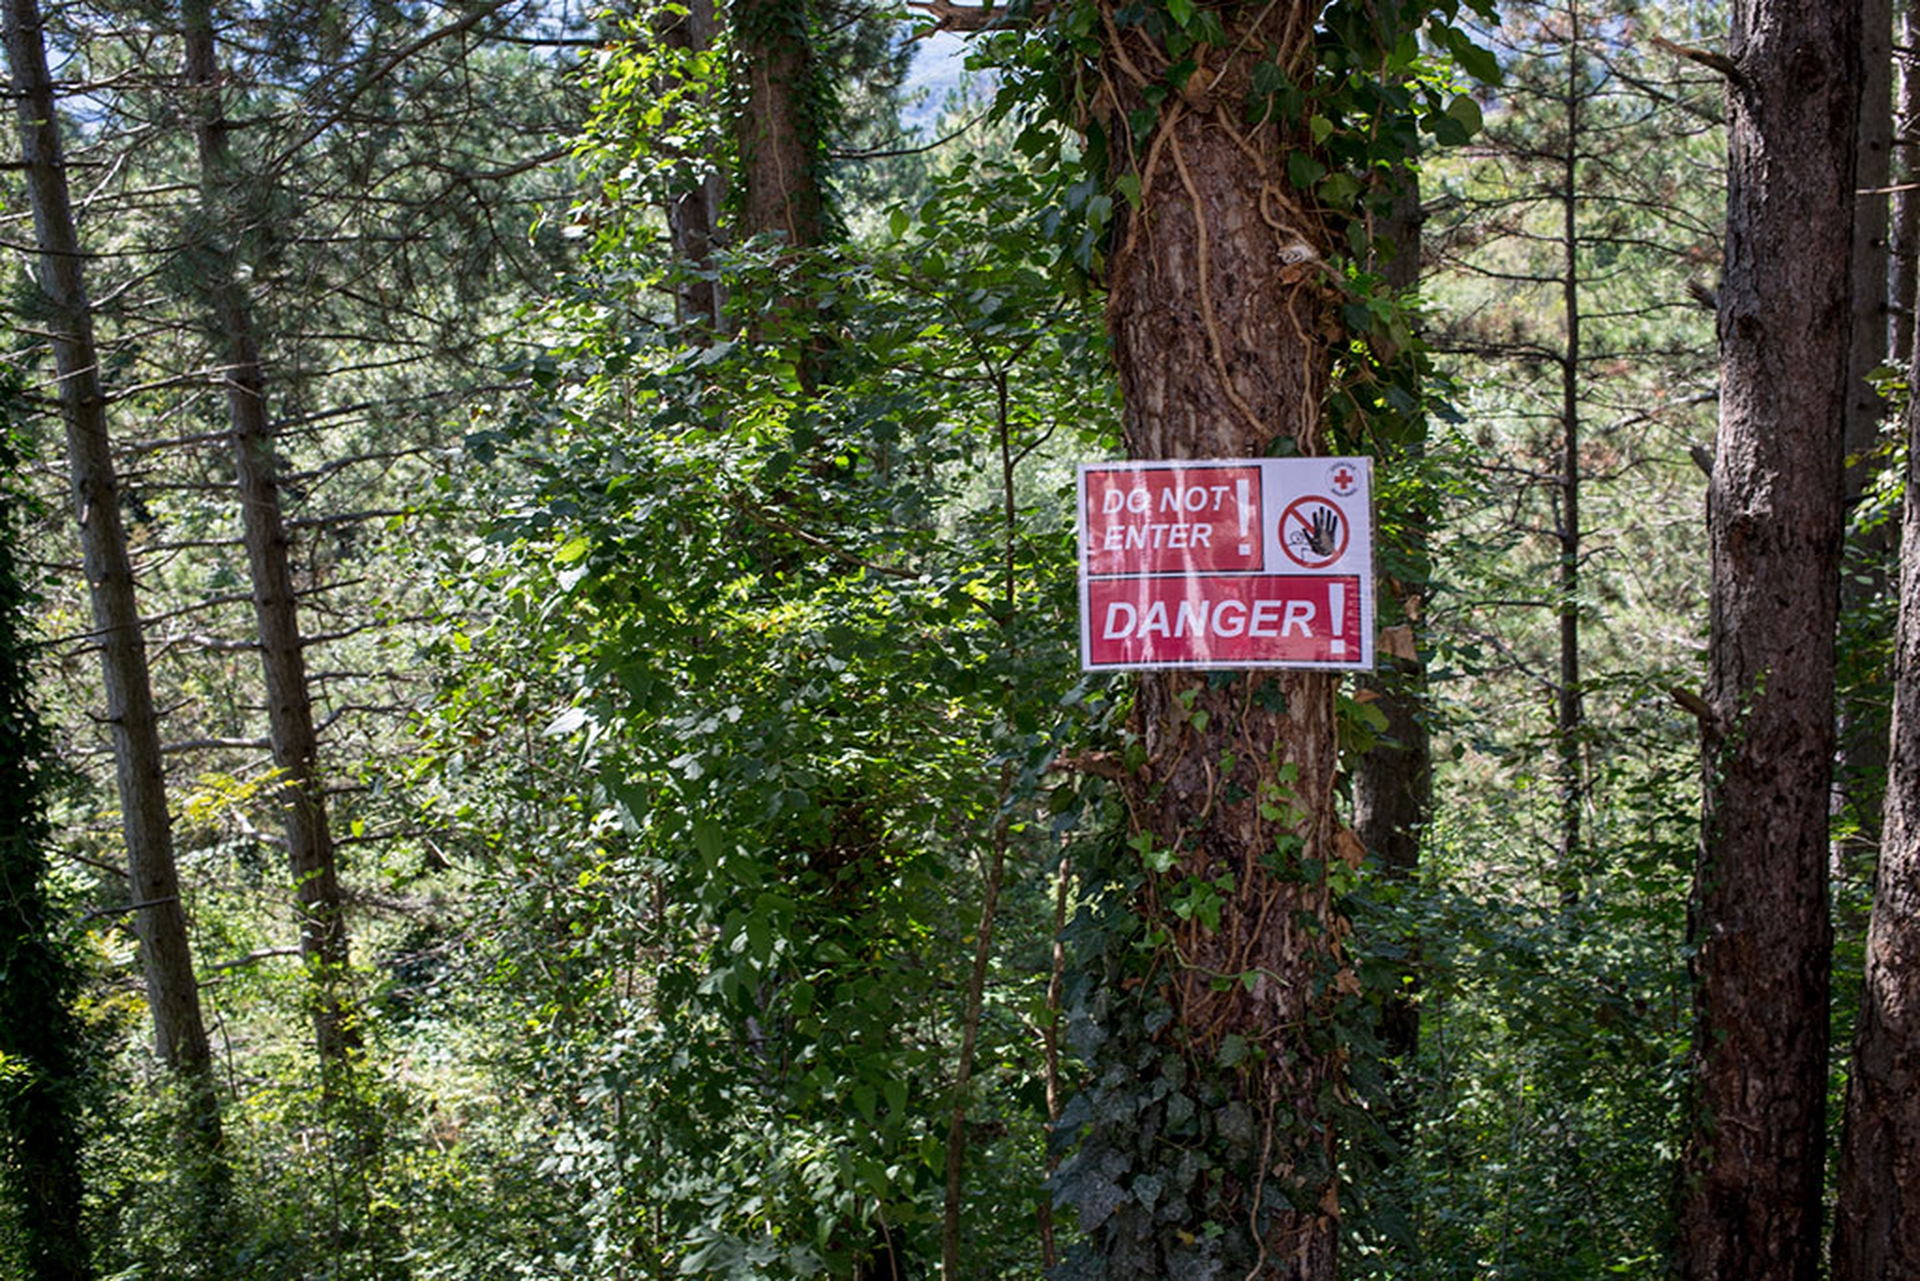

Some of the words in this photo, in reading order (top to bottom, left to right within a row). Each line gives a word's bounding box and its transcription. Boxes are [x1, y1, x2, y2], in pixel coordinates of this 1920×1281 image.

[1102, 488, 1149, 514] DO
[1160, 486, 1230, 512] NOT
[1236, 479, 1251, 556] !
[1104, 523, 1213, 550] ENTER
[1103, 600, 1317, 640] DANGER
[1328, 582, 1346, 654] !
